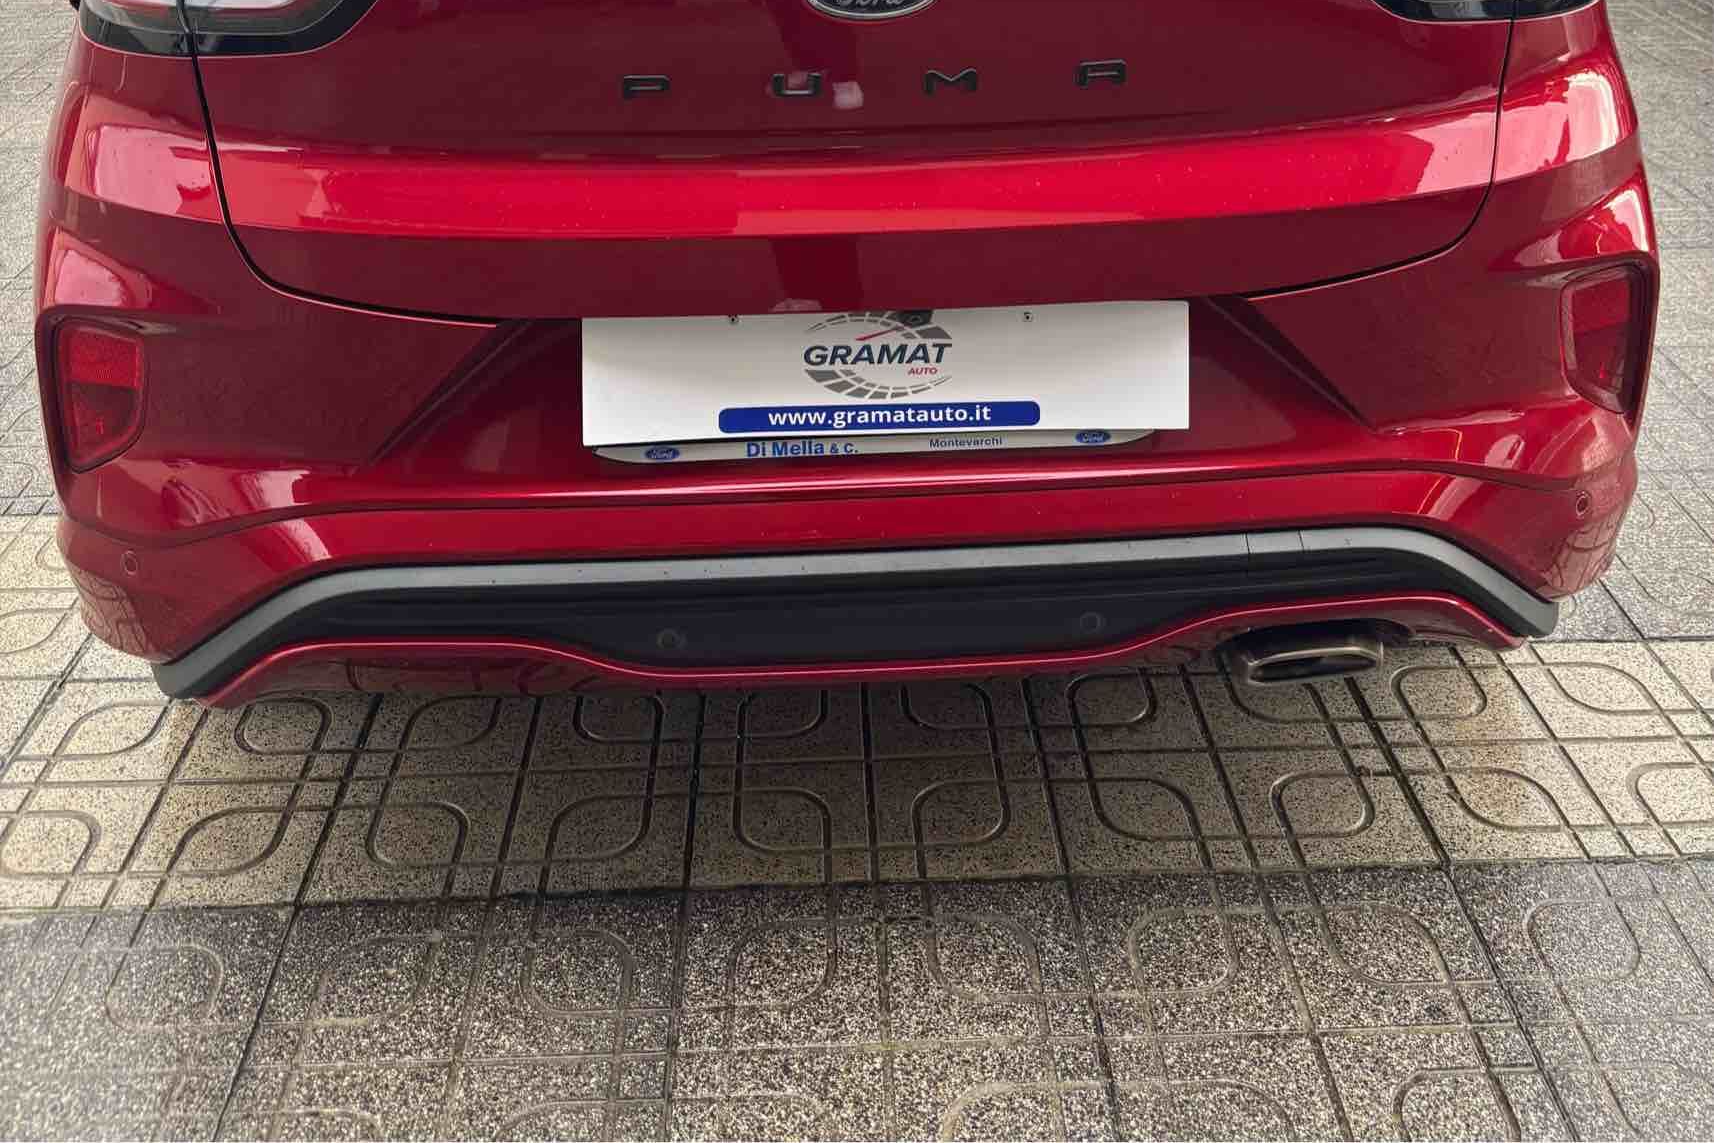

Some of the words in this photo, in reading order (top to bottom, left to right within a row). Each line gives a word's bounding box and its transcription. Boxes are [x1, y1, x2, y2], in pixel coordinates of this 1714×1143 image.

[622, 59, 1128, 101] PUMA
[803, 343, 953, 366] GRAMAT
[907, 367, 938, 376] AUTO
[768, 404, 992, 428] www.gramatauto.it
[746, 441, 766, 458] Di
[772, 439, 825, 456] Mella
[829, 442, 839, 454] &
[929, 437, 1003, 448] Montevarchi
